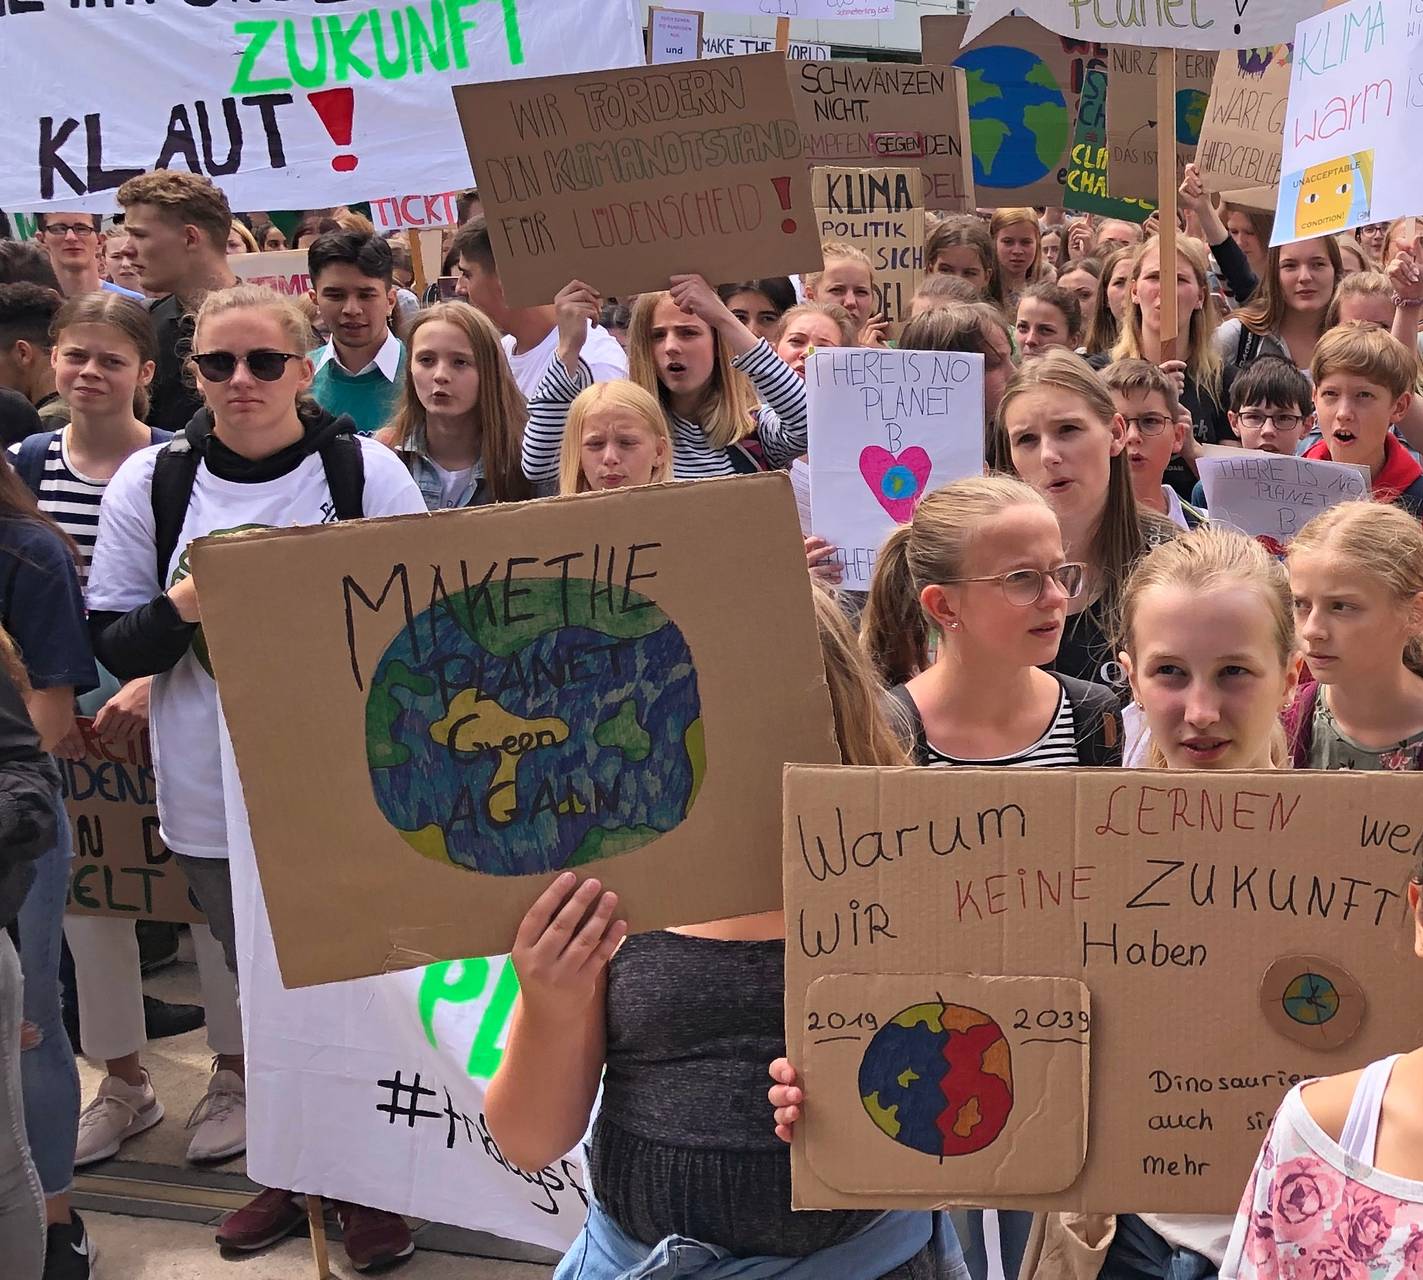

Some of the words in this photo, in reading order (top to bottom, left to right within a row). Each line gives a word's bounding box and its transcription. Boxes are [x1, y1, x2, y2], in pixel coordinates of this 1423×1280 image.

[229, 0, 525, 94] ZUKUNFT
[665, 46, 684, 55] und
[702, 37, 735, 56] MAKE
[788, 43, 827, 61] ORLD
[1298, 3, 1386, 81] KLIMA
[801, 63, 944, 95] SCHWÄNZEN
[1113, 48, 1144, 75] NUR
[509, 93, 569, 141] WIR
[575, 66, 746, 132] FORDERN
[814, 99, 870, 122] NICHT,
[1212, 87, 1273, 132] WÄRE
[1295, 78, 1394, 148] warm
[39, 86, 359, 200] KLAUT!
[875, 134, 922, 154] GEGEN
[924, 134, 962, 156] DEN
[1114, 147, 1139, 164] DAS
[486, 154, 543, 204] DEN
[1293, 160, 1361, 188] UNACCEPTABLE
[826, 173, 914, 215] KLIMA
[499, 210, 556, 257] FÜR
[821, 221, 907, 239] POLITIK
[1301, 212, 1345, 229] CONDITION!
[875, 246, 924, 270] SICH
[814, 352, 896, 387] THERE
[902, 352, 921, 383] IS
[932, 356, 971, 384] NO
[860, 386, 954, 421] PLANET
[885, 422, 903, 453] B
[1214, 458, 1286, 483] THERE
[1295, 460, 1318, 487] IS
[1328, 473, 1363, 495] NO
[1254, 480, 1329, 507] PLANET
[1277, 507, 1298, 535] B
[343, 557, 539, 692] MAKE
[544, 543, 661, 626] THE
[433, 642, 635, 710] PLANET
[448, 712, 557, 763] Green
[449, 774, 622, 838] AGAIN
[798, 803, 1027, 882] Warum
[1095, 784, 1302, 836] LERNEN
[66, 864, 165, 914] ELT
[1126, 858, 1401, 927] ZUKUNFT
[1082, 922, 1207, 968] Haben
[808, 1012, 879, 1031] 2019
[1013, 1008, 1090, 1033] 2039
[1148, 1108, 1214, 1131] auch
